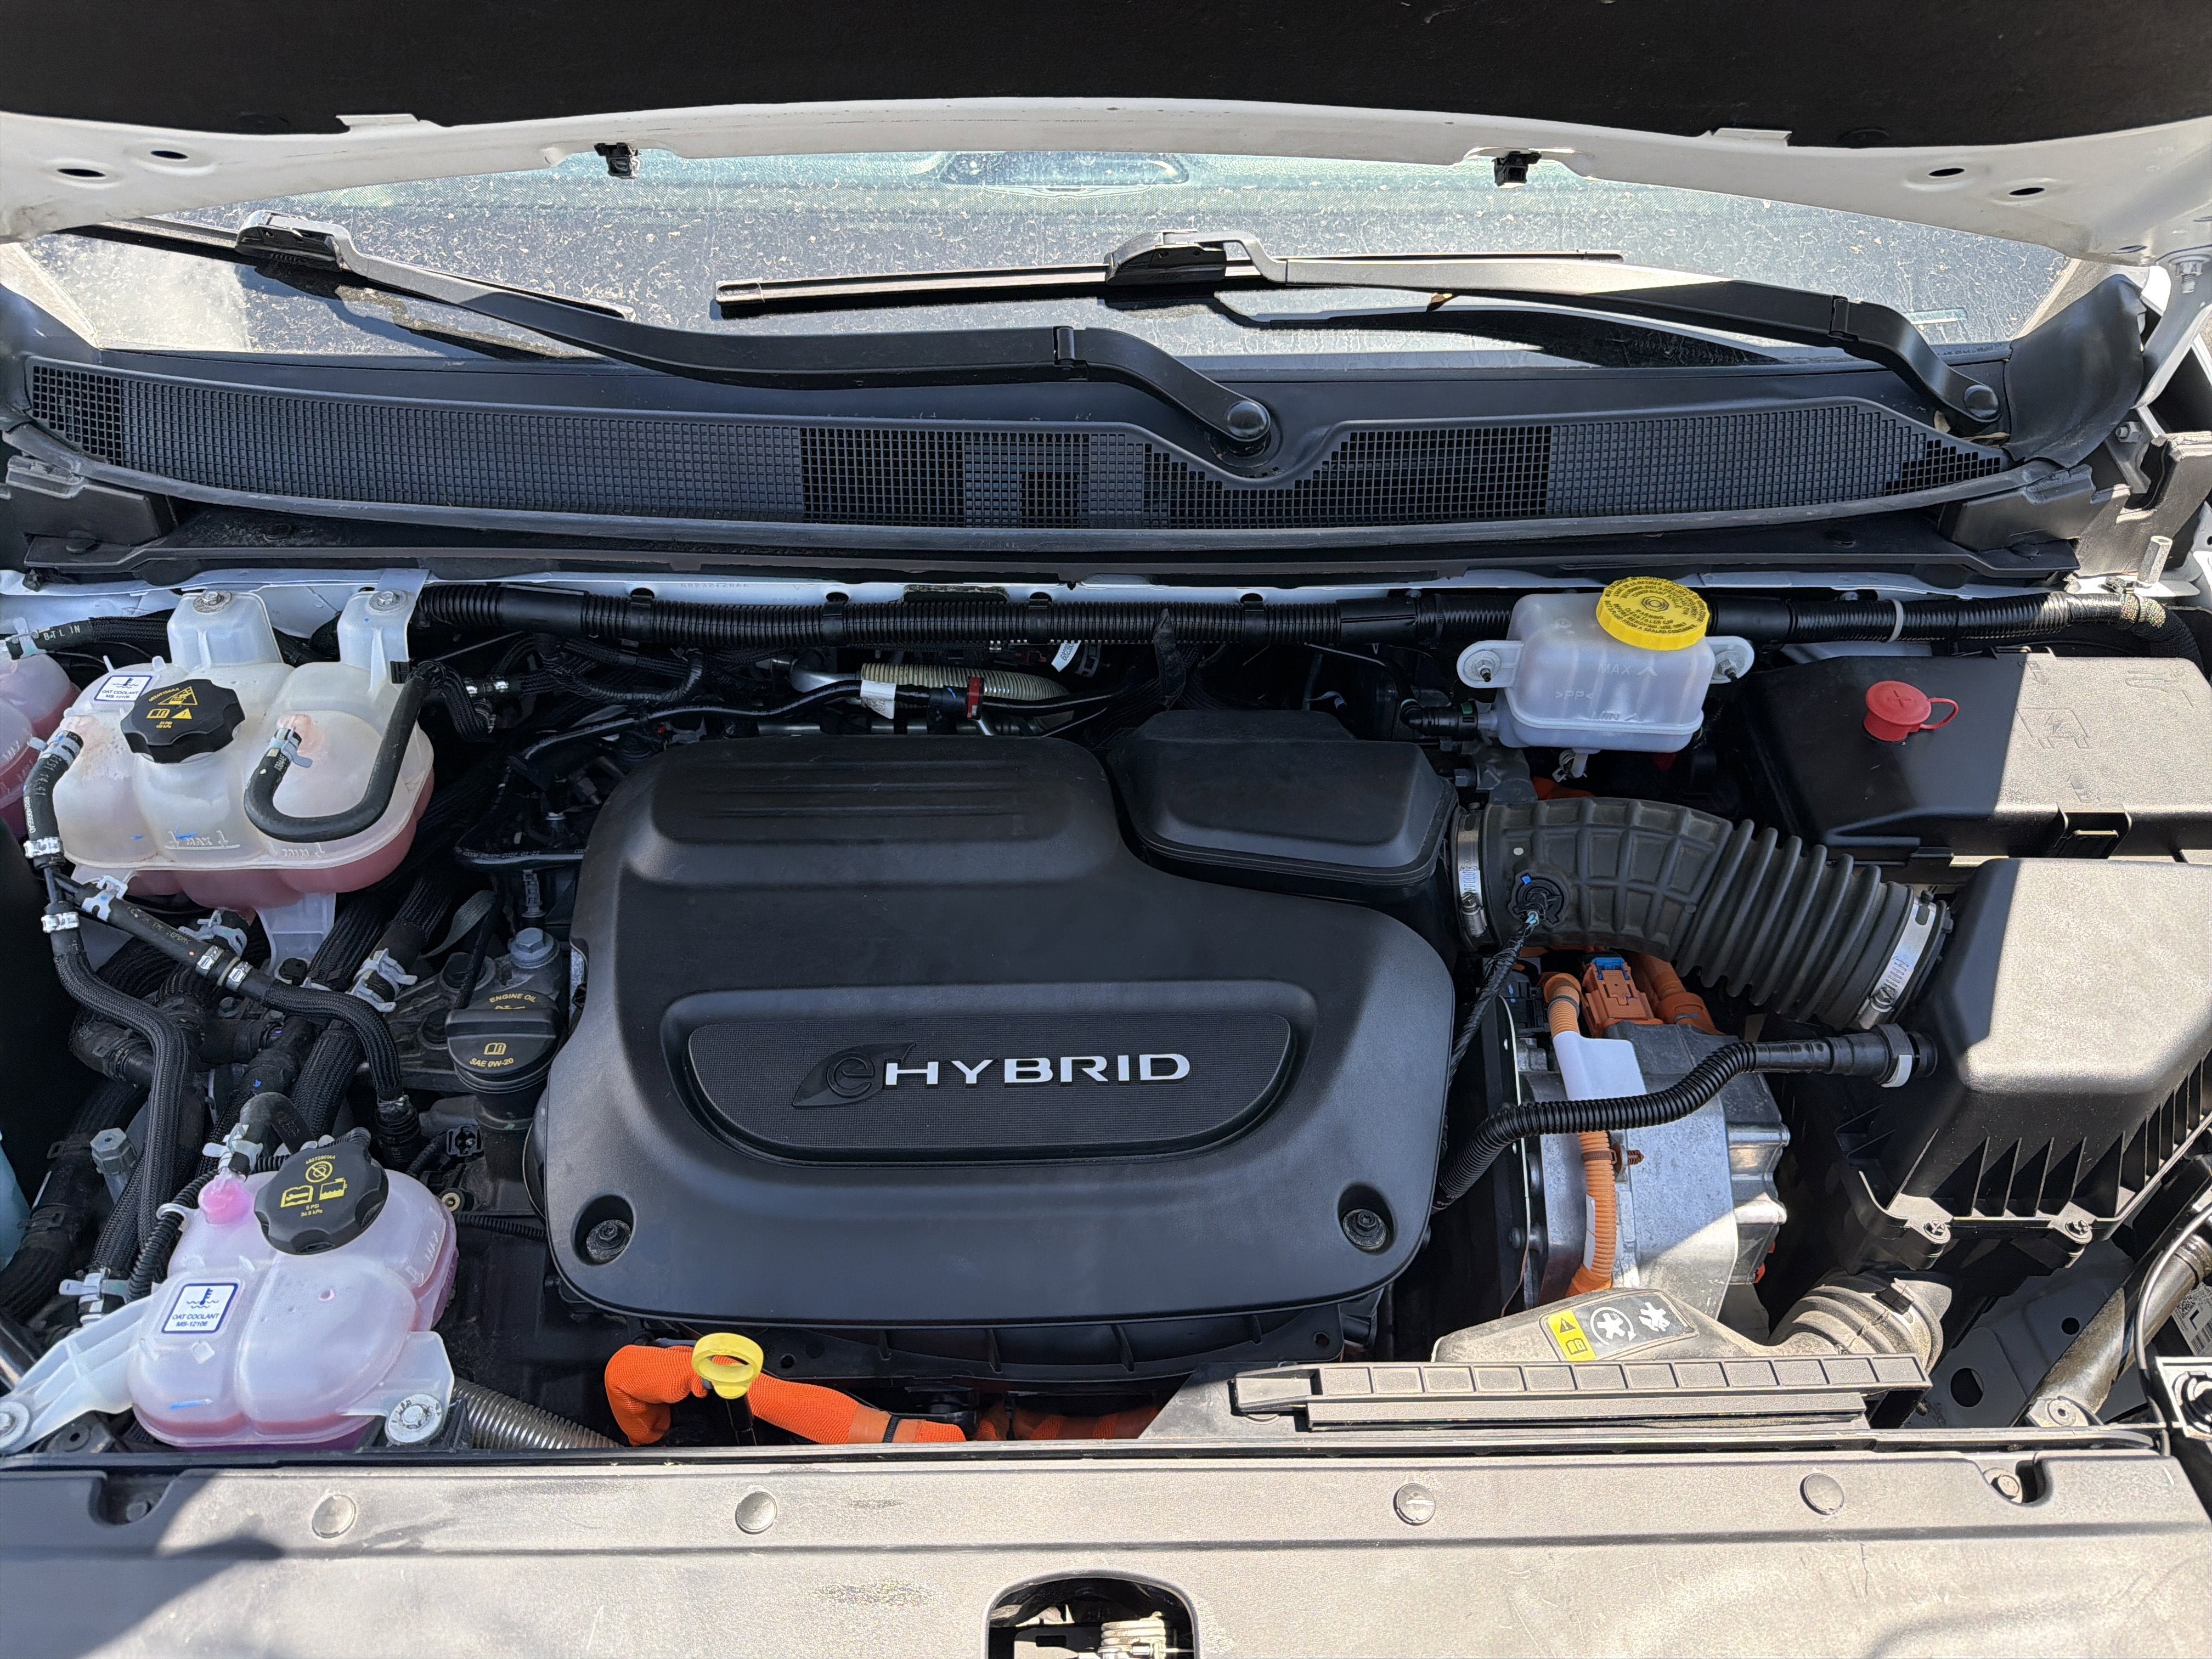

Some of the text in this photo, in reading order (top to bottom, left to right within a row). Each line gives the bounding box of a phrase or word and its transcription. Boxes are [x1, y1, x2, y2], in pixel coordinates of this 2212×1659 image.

[1624, 607, 1641, 619] CLEAN
[1641, 616, 1661, 625] FILLER
[1622, 619, 1638, 628] FROM
[70, 625, 81, 634] IN
[1598, 663, 1632, 675] MAX
[489, 993, 537, 1003] ENGINE OIL
[469, 1057, 515, 1068] SAE 0W-20
